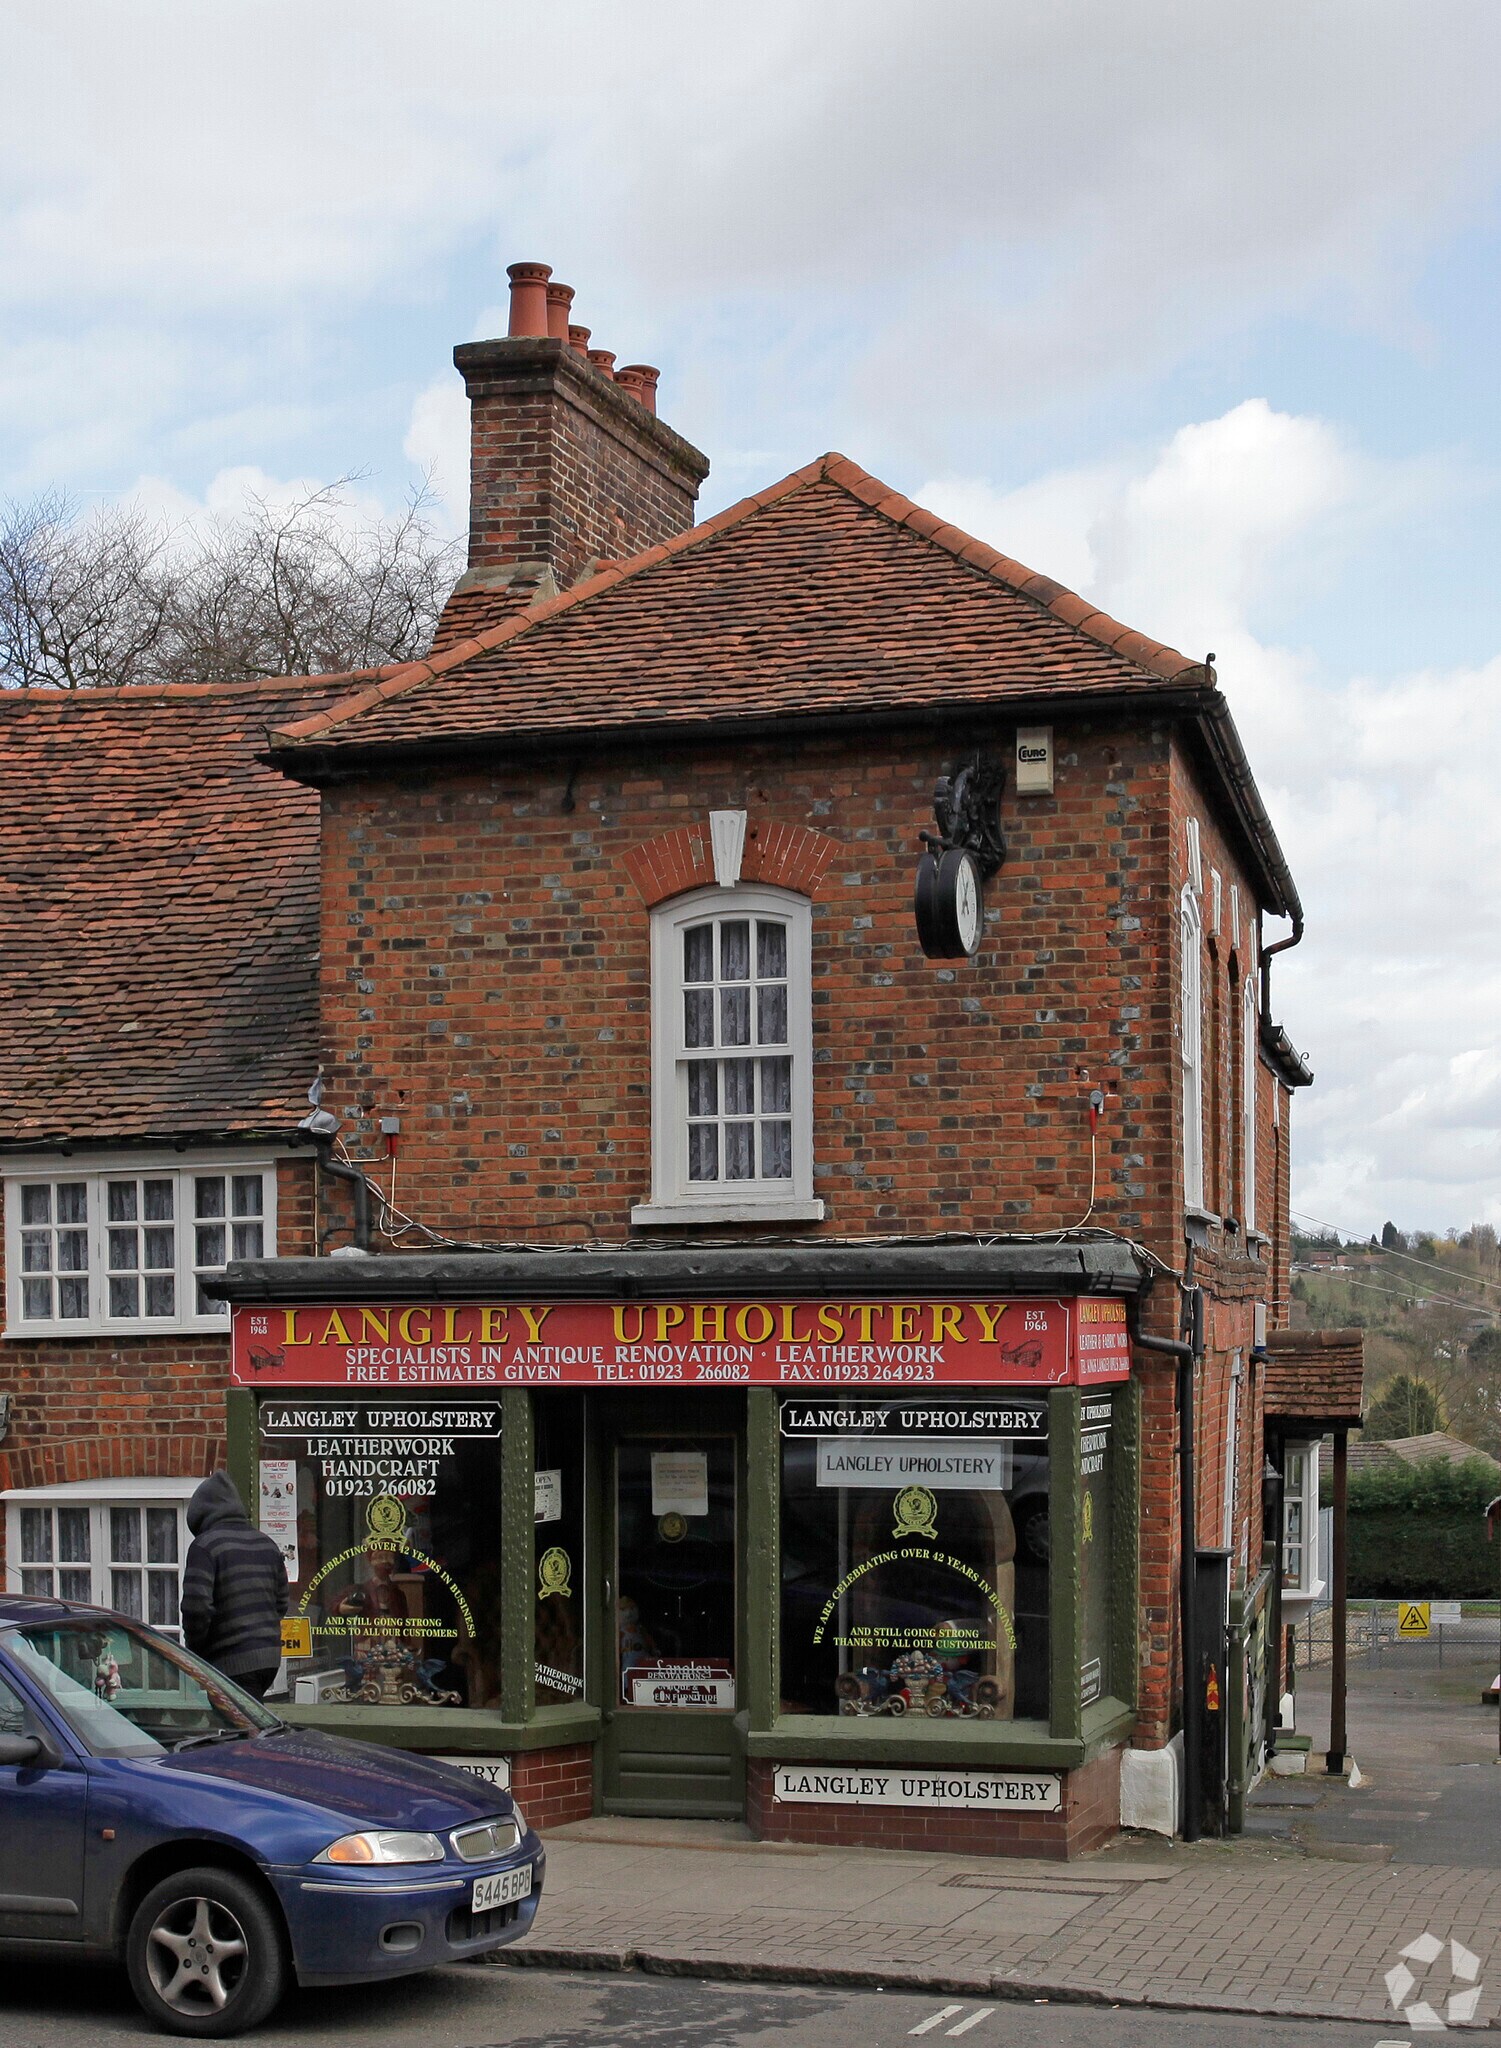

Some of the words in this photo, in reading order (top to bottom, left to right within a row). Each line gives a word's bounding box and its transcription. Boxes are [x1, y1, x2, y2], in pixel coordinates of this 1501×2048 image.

[1026, 1310, 1046, 1320] EST
[250, 1325, 268, 1335] 1968
[281, 1306, 556, 1346] LANGLEY
[610, 1303, 1009, 1345] UPHOLSTERY
[1024, 1320, 1048, 1331] 1968
[345, 1346, 471, 1365] SPECIALISTS
[481, 1346, 502, 1365] IN
[512, 1346, 604, 1366] ANTIQUE
[614, 1345, 753, 1365] RENOVATION
[774, 1344, 945, 1364] LEATHERWORK
[346, 1366, 390, 1381] FREE
[399, 1365, 497, 1381] ESTIMATES
[504, 1365, 561, 1380] GIVEN
[593, 1364, 635, 1380] TEL:
[638, 1364, 683, 1380] 01923
[695, 1364, 751, 1380] 266082
[822, 1364, 870, 1380] 01923
[872, 1364, 935, 1381] 264923
[266, 1411, 358, 1428] LANGLEY
[366, 1411, 496, 1428] UPHOLSTERY
[789, 1410, 890, 1428] LANGLEY
[900, 1410, 1043, 1429] UPHOLSTERY
[306, 1438, 455, 1457] LEATHERWORK
[321, 1459, 440, 1477] HANDCRAFT
[826, 1455, 893, 1472] LANGLEY
[899, 1456, 995, 1474] UPHOLSTERY
[325, 1479, 374, 1496] 01923
[379, 1479, 436, 1496] 266082
[298, 1590, 312, 1615] ARE
[308, 1544, 368, 1591] CELEBRATING
[370, 1541, 397, 1552] OVER
[411, 1548, 442, 1574] YEARS
[440, 1571, 453, 1585] IN
[449, 1583, 477, 1638] BUSINESS
[813, 1625, 825, 1644] WE
[819, 1600, 835, 1625] ARE
[832, 1550, 899, 1600] CELEBRATING
[900, 1548, 930, 1559] OVER
[932, 1551, 945, 1563] 42
[947, 1555, 980, 1582] YEARS
[977, 1579, 992, 1594] IN
[988, 1591, 1017, 1650] BUSINESS
[325, 1616, 345, 1625] AND
[346, 1616, 372, 1626] STILL
[373, 1617, 403, 1627] GOING
[405, 1618, 442, 1627] STRONG
[311, 1627, 347, 1636] THANKS
[349, 1627, 361, 1636] TO
[363, 1628, 380, 1637] ALL
[382, 1628, 401, 1637] OUR
[402, 1628, 458, 1638] CUSTOMERS
[850, 1627, 872, 1637] AND
[873, 1627, 902, 1637] STILL
[903, 1628, 936, 1638] GOING
[938, 1629, 979, 1638] STRONG
[833, 1637, 873, 1648] THANKS
[875, 1638, 890, 1648] TO
[891, 1638, 911, 1648] ALL
[913, 1639, 934, 1649] OUR
[936, 1640, 997, 1650] CUSTOMERS
[784, 1775, 890, 1795] LANGLEY
[901, 1779, 1051, 1801] UPHOLSTERY
[475, 1876, 510, 1908] S445
